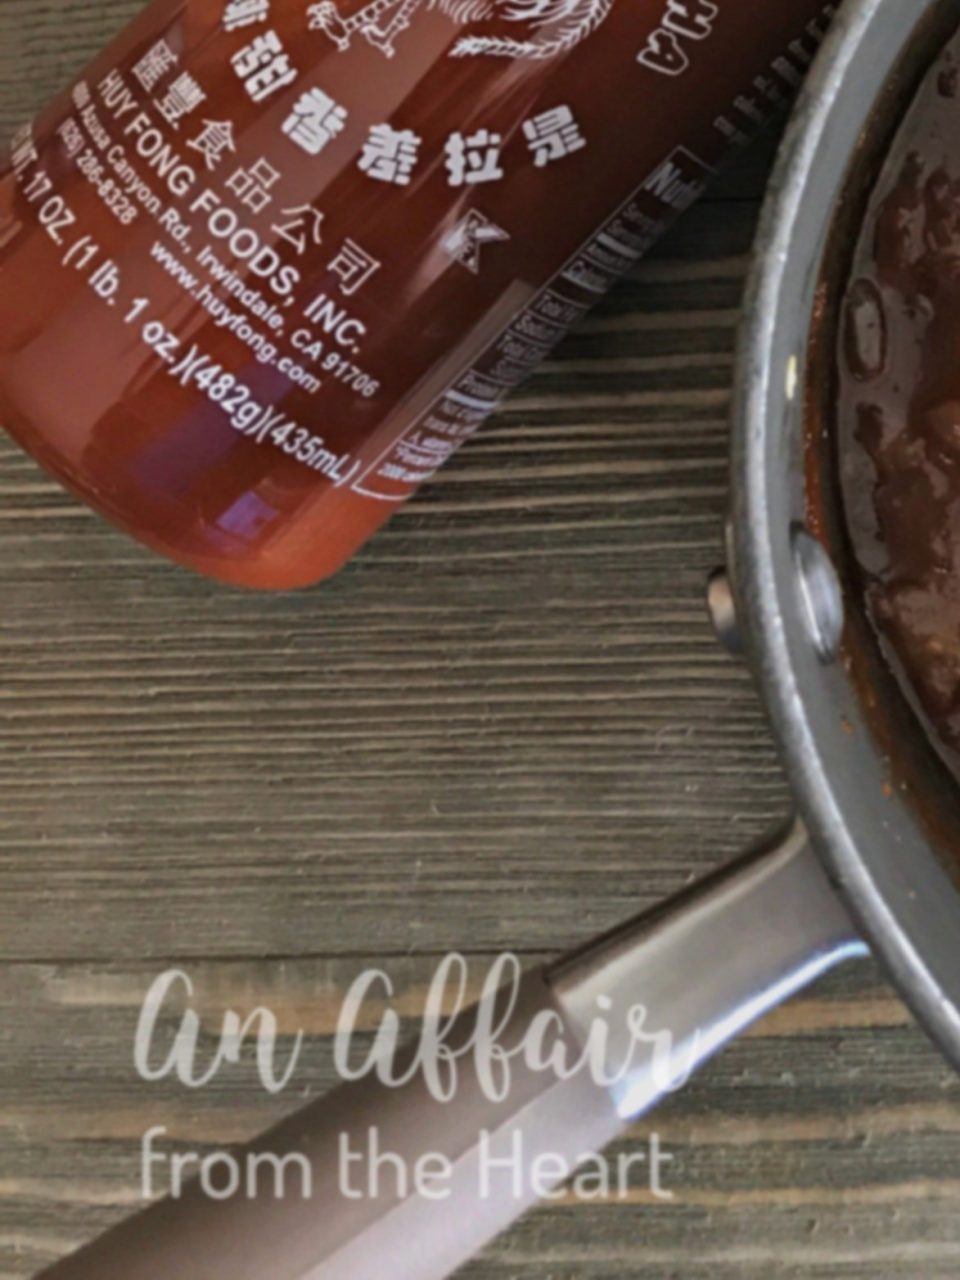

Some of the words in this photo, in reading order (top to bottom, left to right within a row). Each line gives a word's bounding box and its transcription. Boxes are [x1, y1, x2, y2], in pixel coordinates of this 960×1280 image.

[98, 69, 138, 119] HUY
[124, 112, 196, 197] FONG
[189, 189, 300, 307] FOODS,
[303, 293, 367, 355] INC.
[107, 144, 162, 215] Canyon
[196, 245, 285, 337] Irwindale,
[290, 328, 324, 362] CA
[322, 352, 381, 399] 91706
[124, 297, 149, 322] 1
[150, 240, 323, 394] www.huyfong.com
